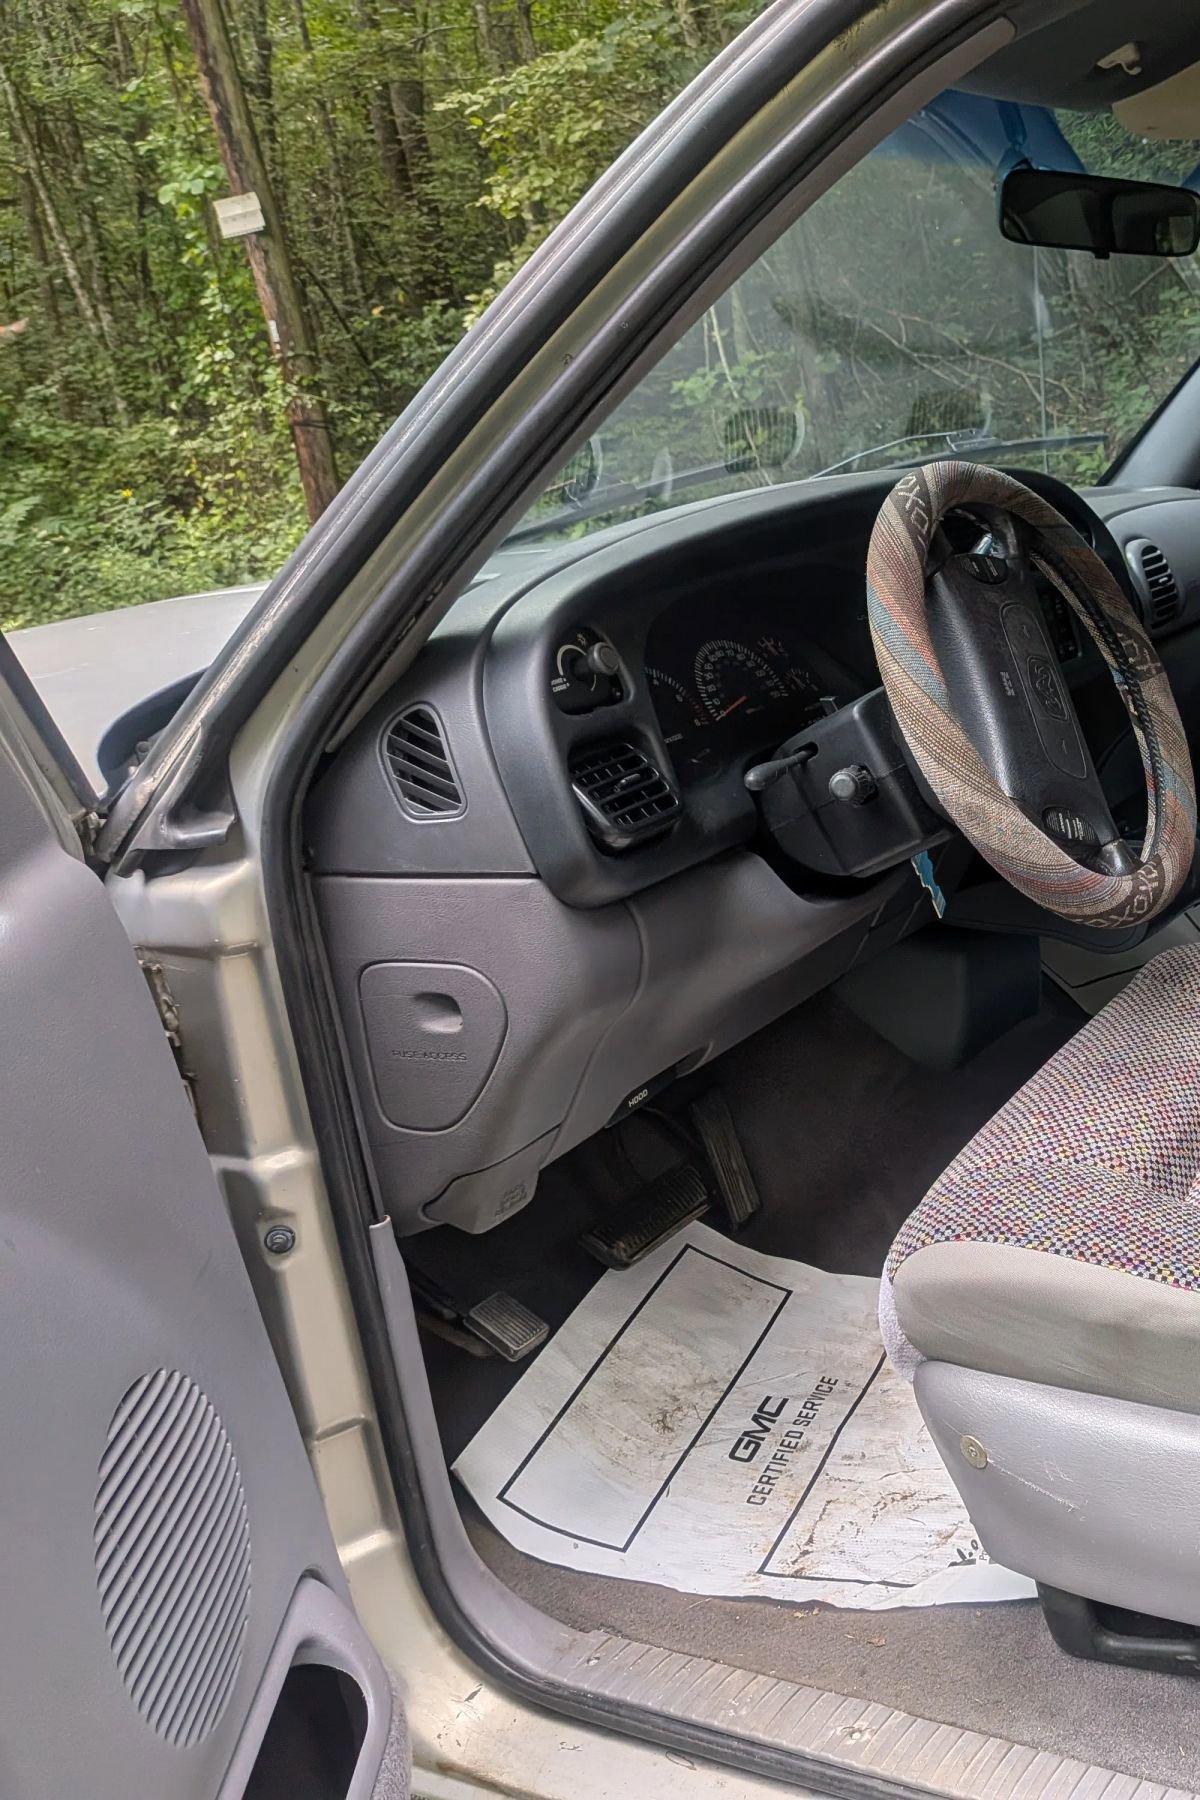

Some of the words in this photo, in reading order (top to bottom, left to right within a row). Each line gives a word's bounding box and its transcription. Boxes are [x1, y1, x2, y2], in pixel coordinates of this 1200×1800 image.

[392, 1050, 419, 1058] FUSE
[423, 1051, 467, 1060] ACCESS
[628, 1088, 649, 1108] HOOD
[728, 1395, 789, 1463] GMC
[746, 1430, 804, 1506] CERTIFIED
[792, 1376, 839, 1427] SERVICE
